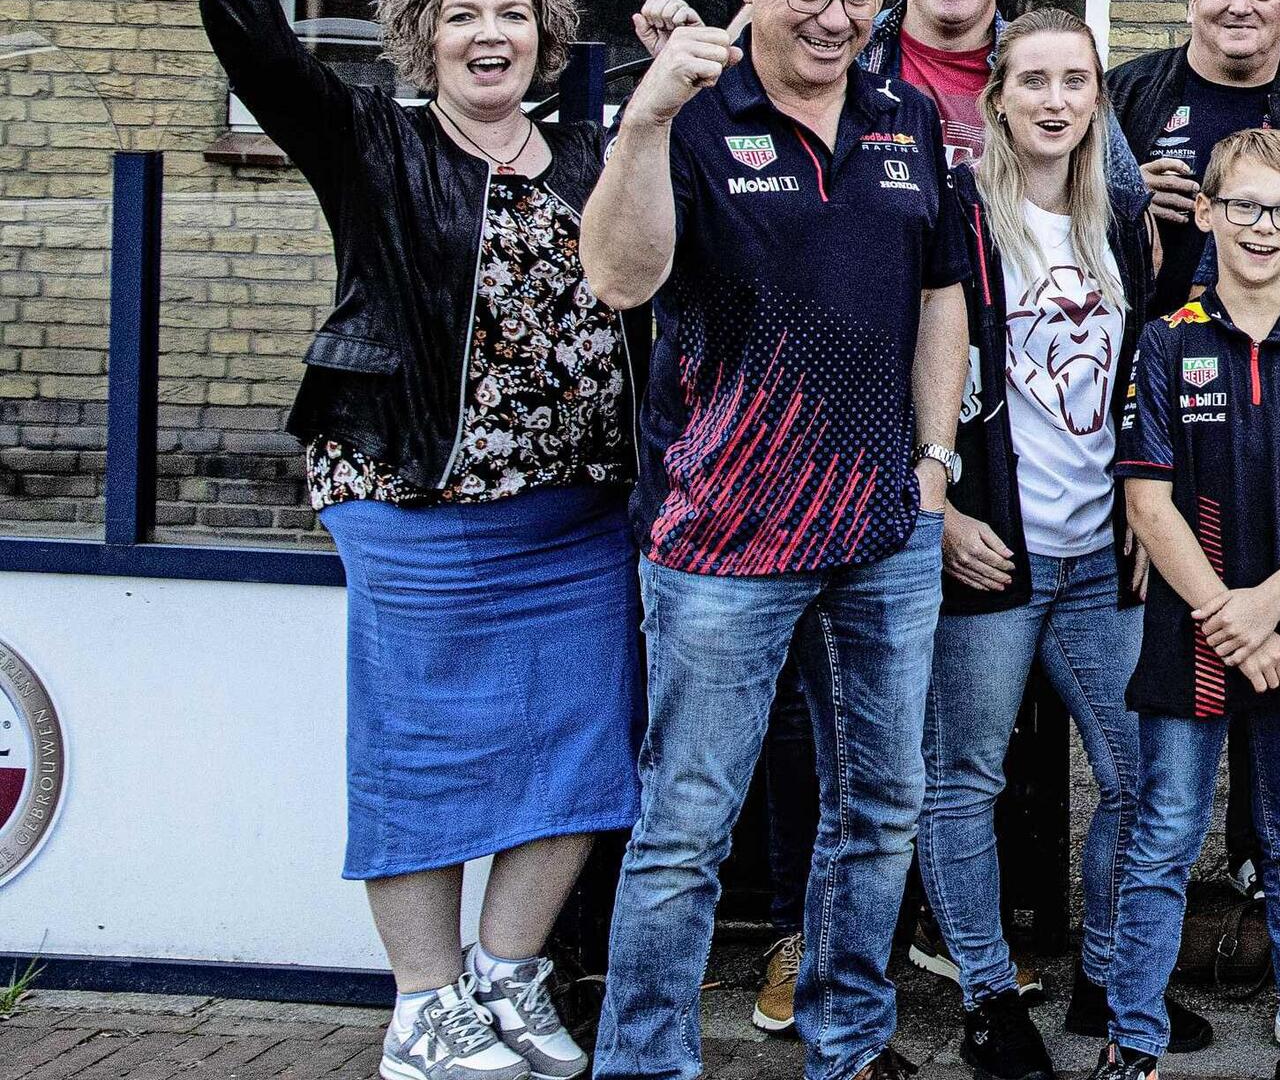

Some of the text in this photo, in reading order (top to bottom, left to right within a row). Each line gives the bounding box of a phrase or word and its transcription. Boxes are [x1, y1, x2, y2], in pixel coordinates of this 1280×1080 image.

[733, 138, 771, 150] TAG
[861, 145, 919, 153] RACING
[733, 150, 776, 169] HEUER
[728, 177, 780, 194] Mobil
[880, 181, 920, 191] HONDA
[1185, 360, 1215, 370] TAG
[1184, 370, 1218, 385] HEUER
[1180, 393, 1211, 409] Mobil
[1182, 413, 1226, 423] ORACLE
